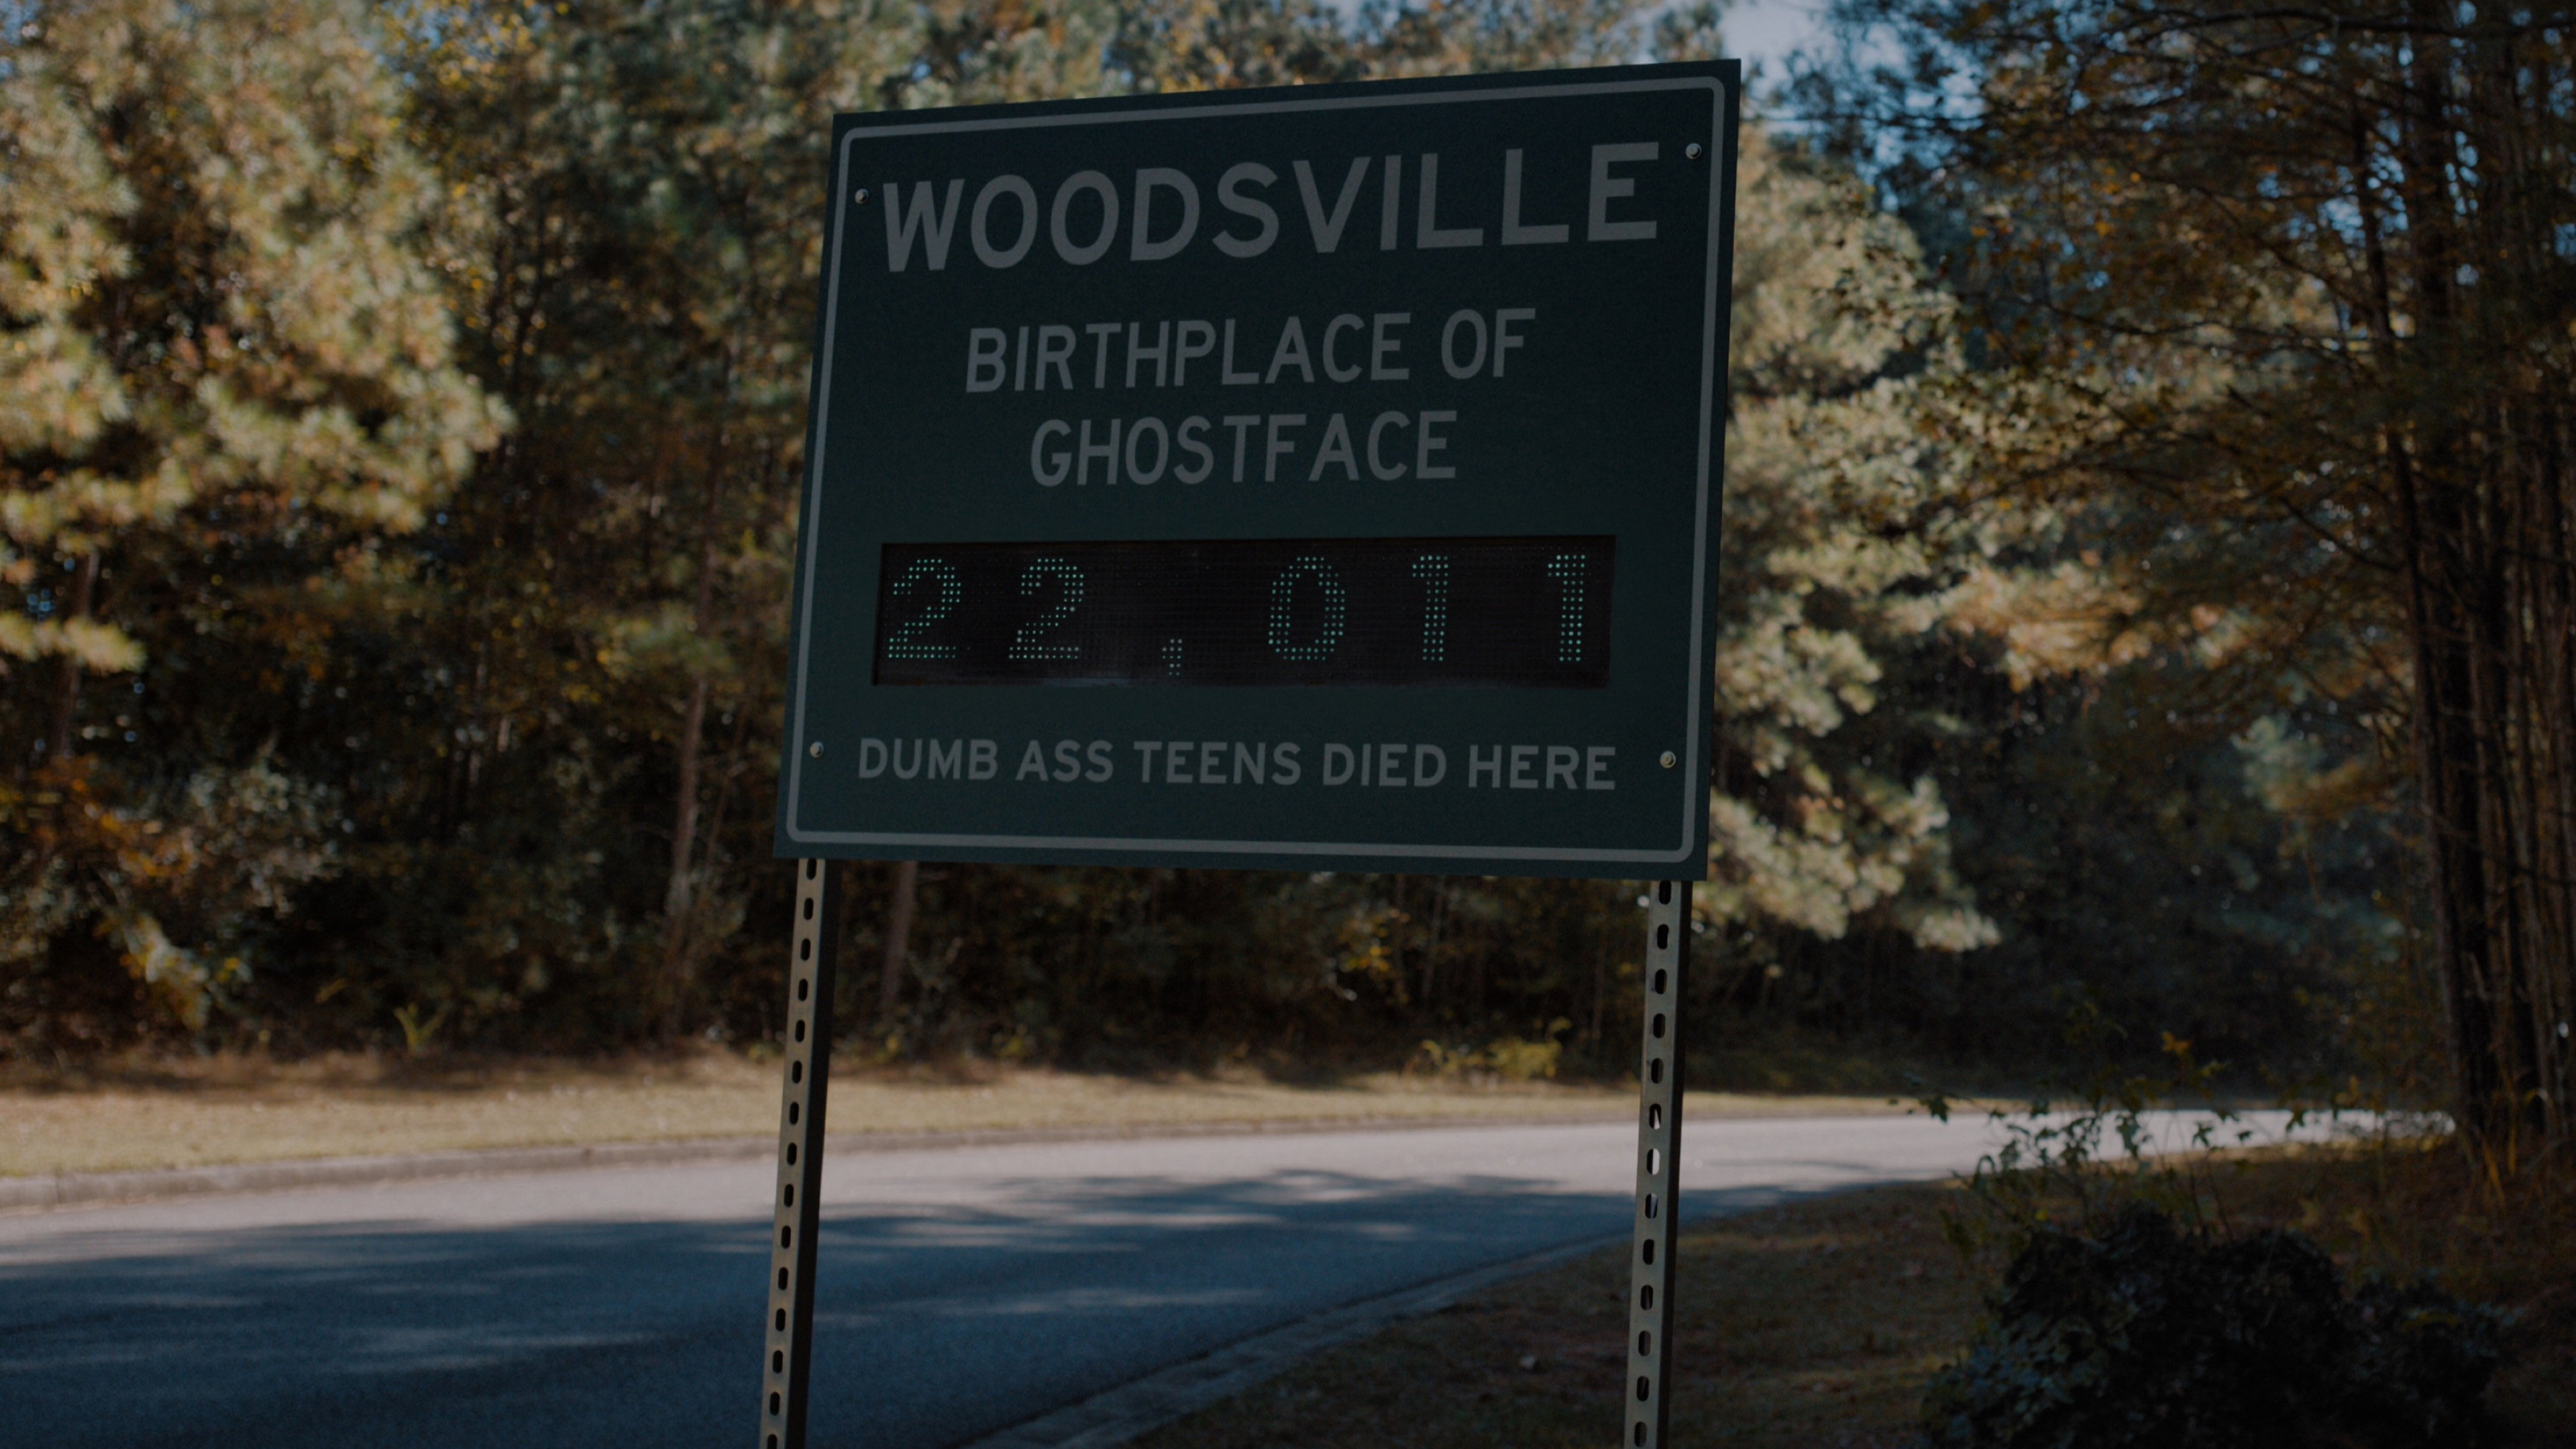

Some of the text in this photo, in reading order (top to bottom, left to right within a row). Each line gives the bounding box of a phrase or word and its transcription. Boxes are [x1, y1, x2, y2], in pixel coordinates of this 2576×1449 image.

[883, 141, 1660, 272] WOODSVILLE
[965, 307, 1537, 393] BIRTHPLACE OF
[1030, 411, 1458, 488] GHOSTFACE
[858, 737, 1616, 791] DUMB ASS TEENS DIED HERE
